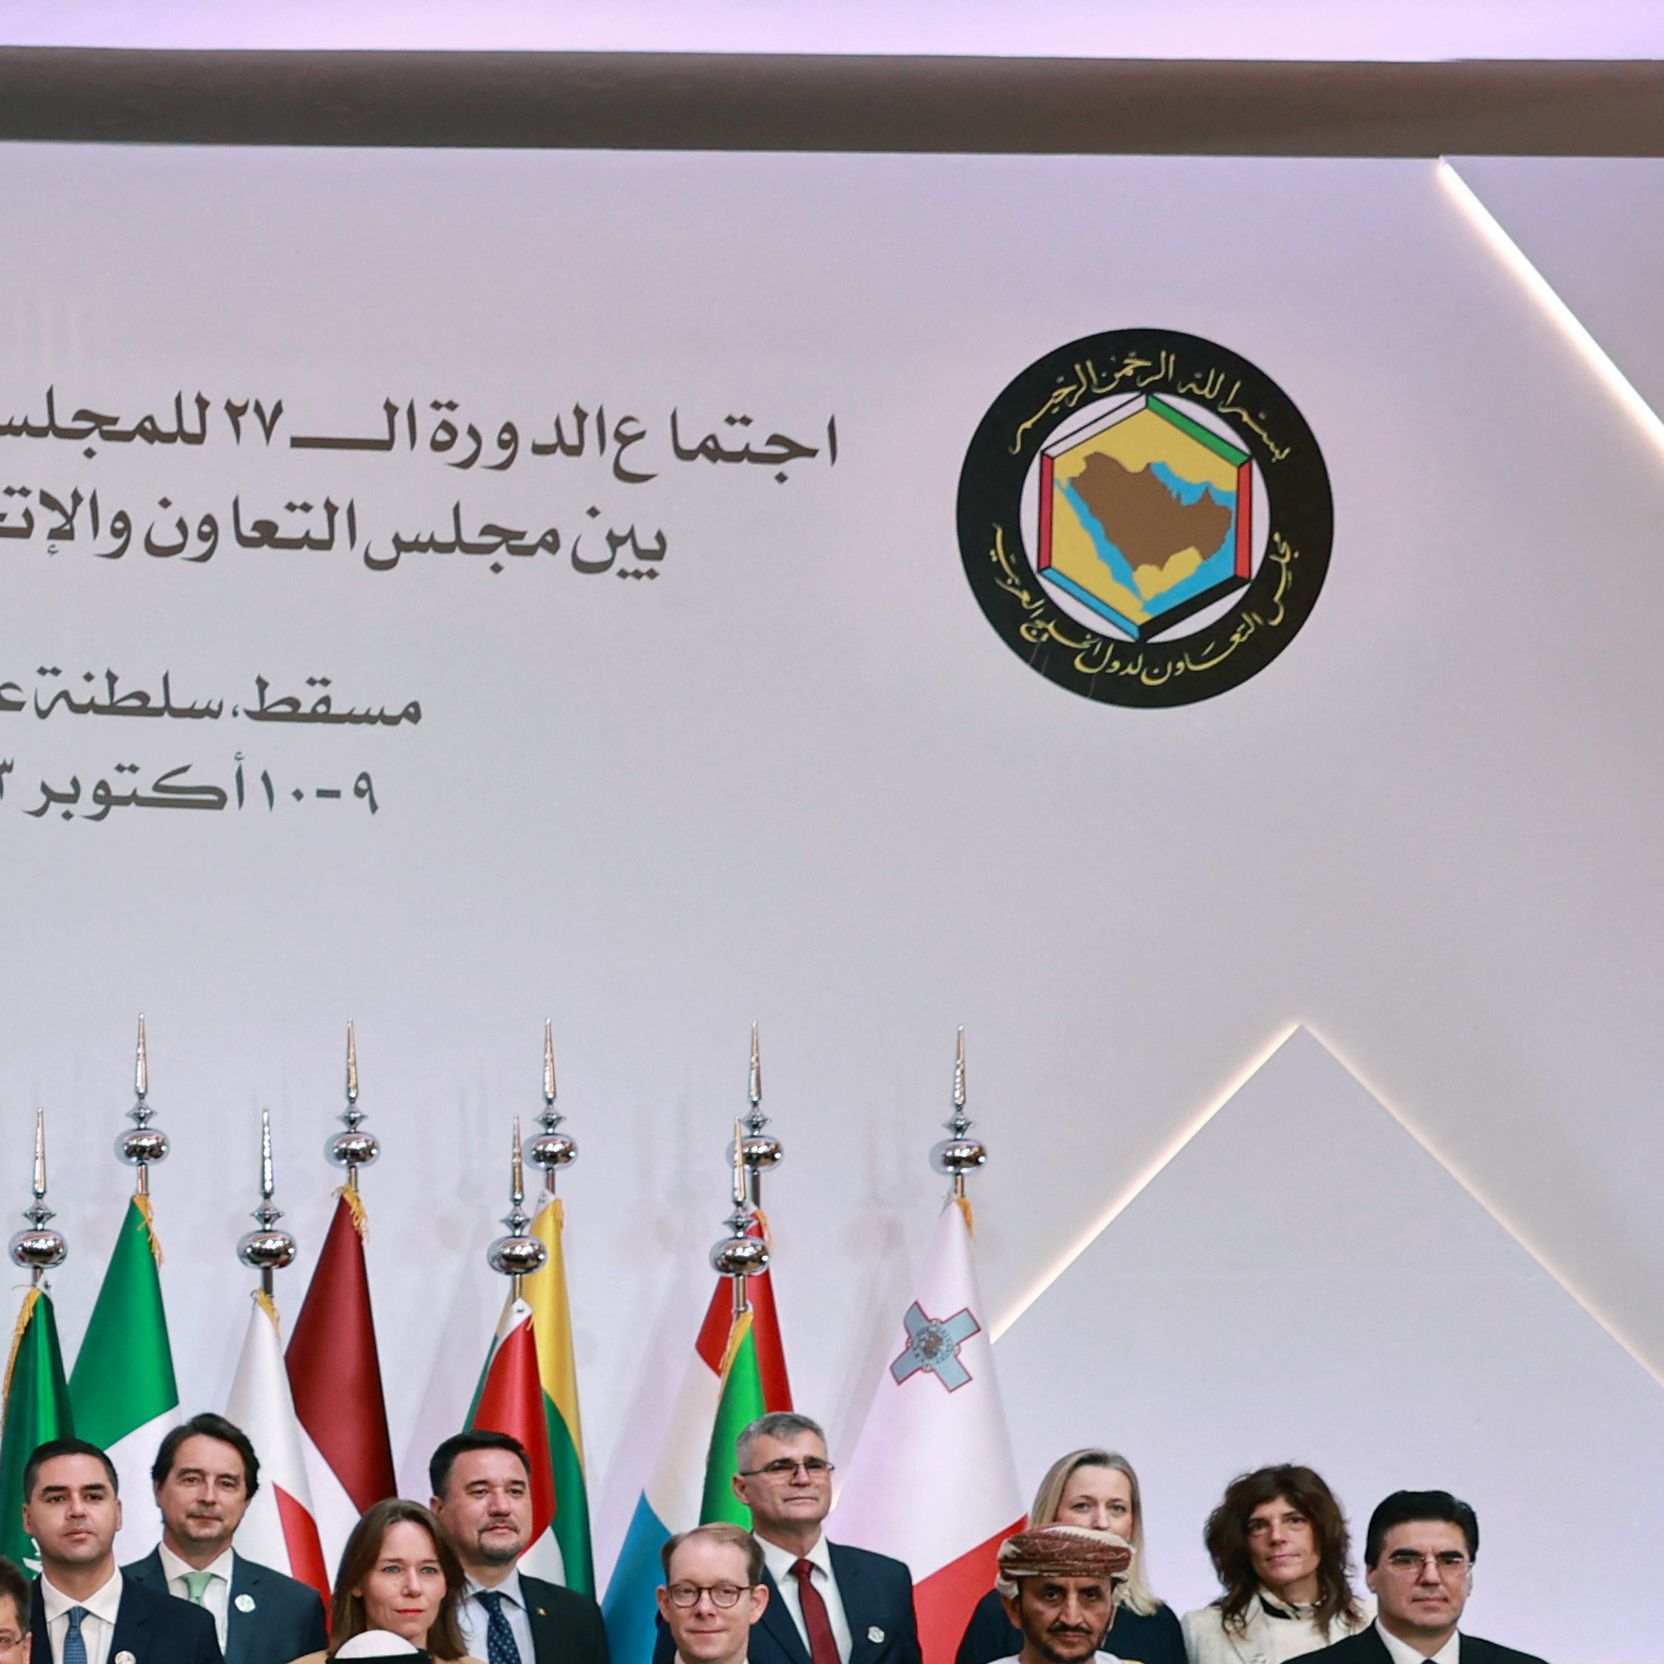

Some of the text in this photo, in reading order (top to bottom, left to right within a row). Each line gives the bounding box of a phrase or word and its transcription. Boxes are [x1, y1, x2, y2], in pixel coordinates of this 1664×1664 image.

[429, 399, 607, 472] الدورة
[612, 407, 838, 485] اجتماع
[143, 495, 357, 564] التعاون
[363, 500, 561, 575] مجلس
[570, 505, 668, 581] بين
[33, 665, 224, 720] سلطنة
[24, 751, 245, 822] أكتوبر
